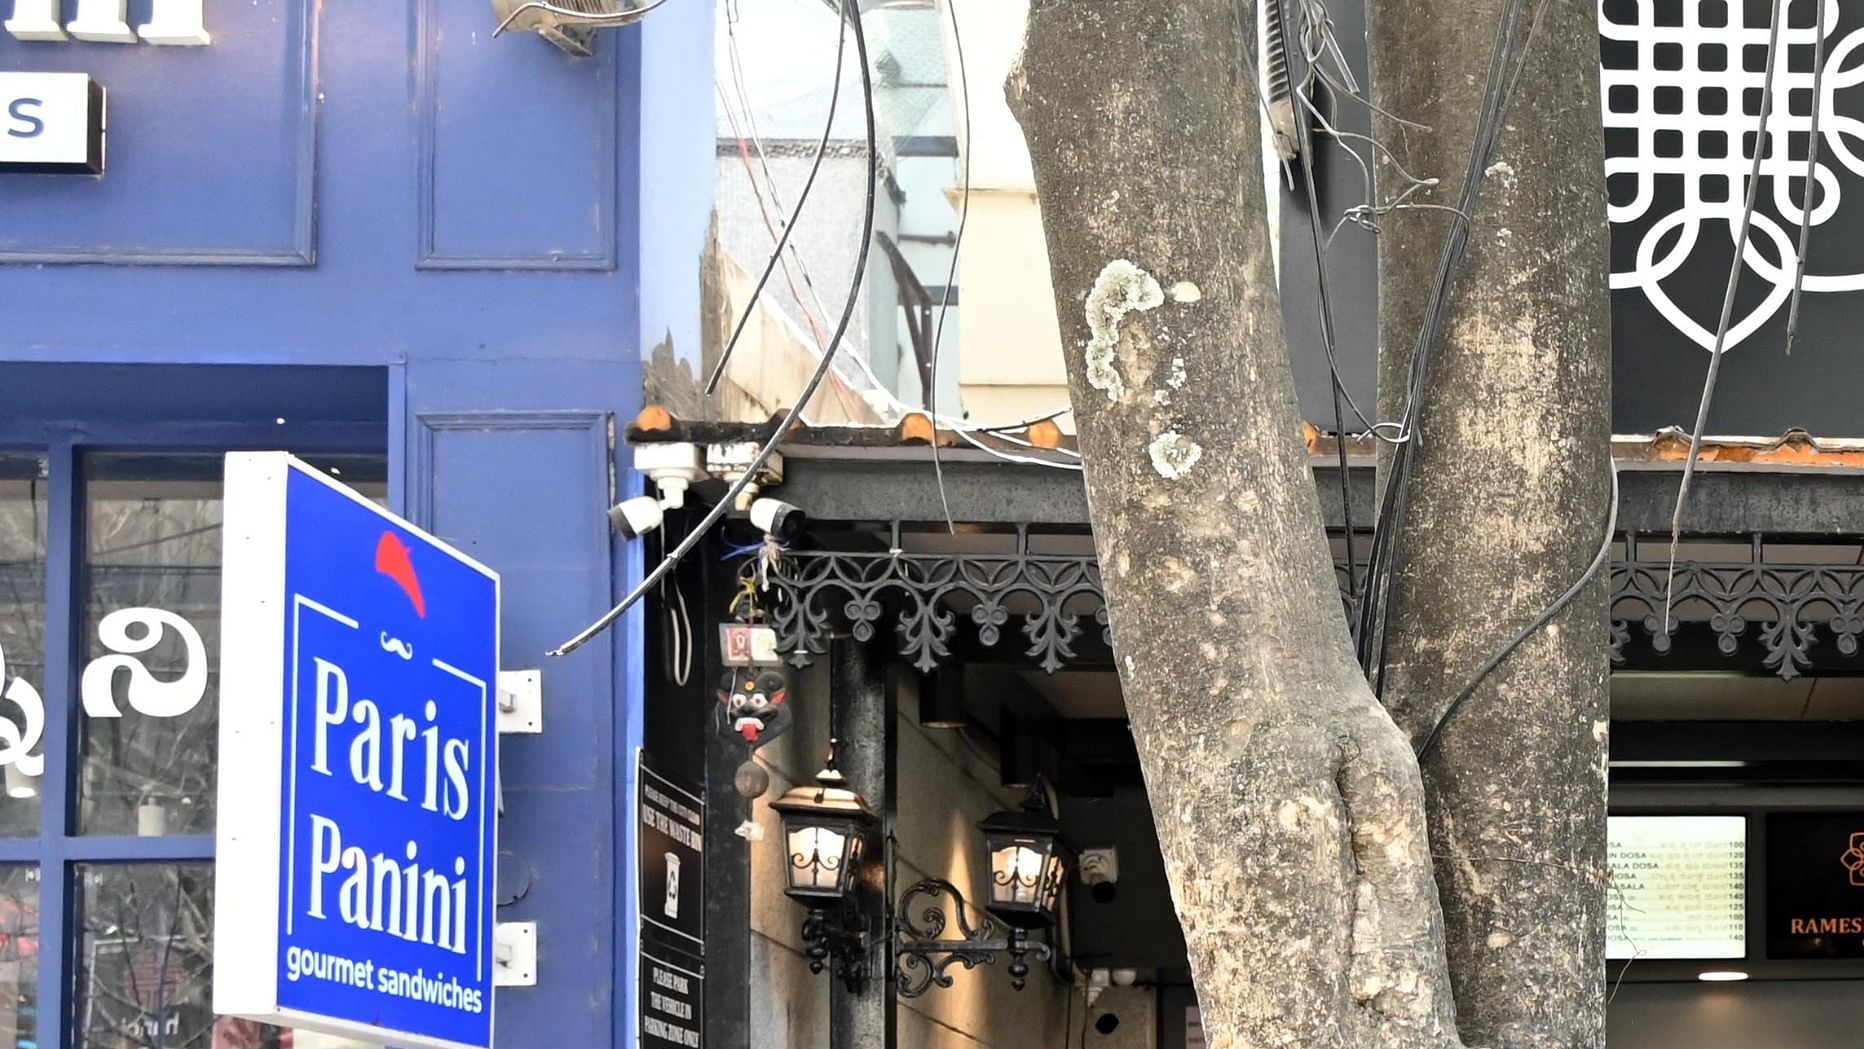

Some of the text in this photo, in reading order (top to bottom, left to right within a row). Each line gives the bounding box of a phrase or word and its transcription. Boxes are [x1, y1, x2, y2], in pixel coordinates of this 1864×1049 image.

[310, 656, 470, 821] Paris
[643, 804, 656, 828] USE
[656, 810, 669, 836] THE
[668, 818, 691, 847] WASTE
[307, 812, 468, 954] Panini
[287, 945, 482, 1014] gourmet sandwiches
[653, 966, 689, 995] PLEASE PARK
[651, 991, 692, 1021] THE VEHICLE IN
[644, 1015, 700, 1049] PARKING ZONE ONLY
